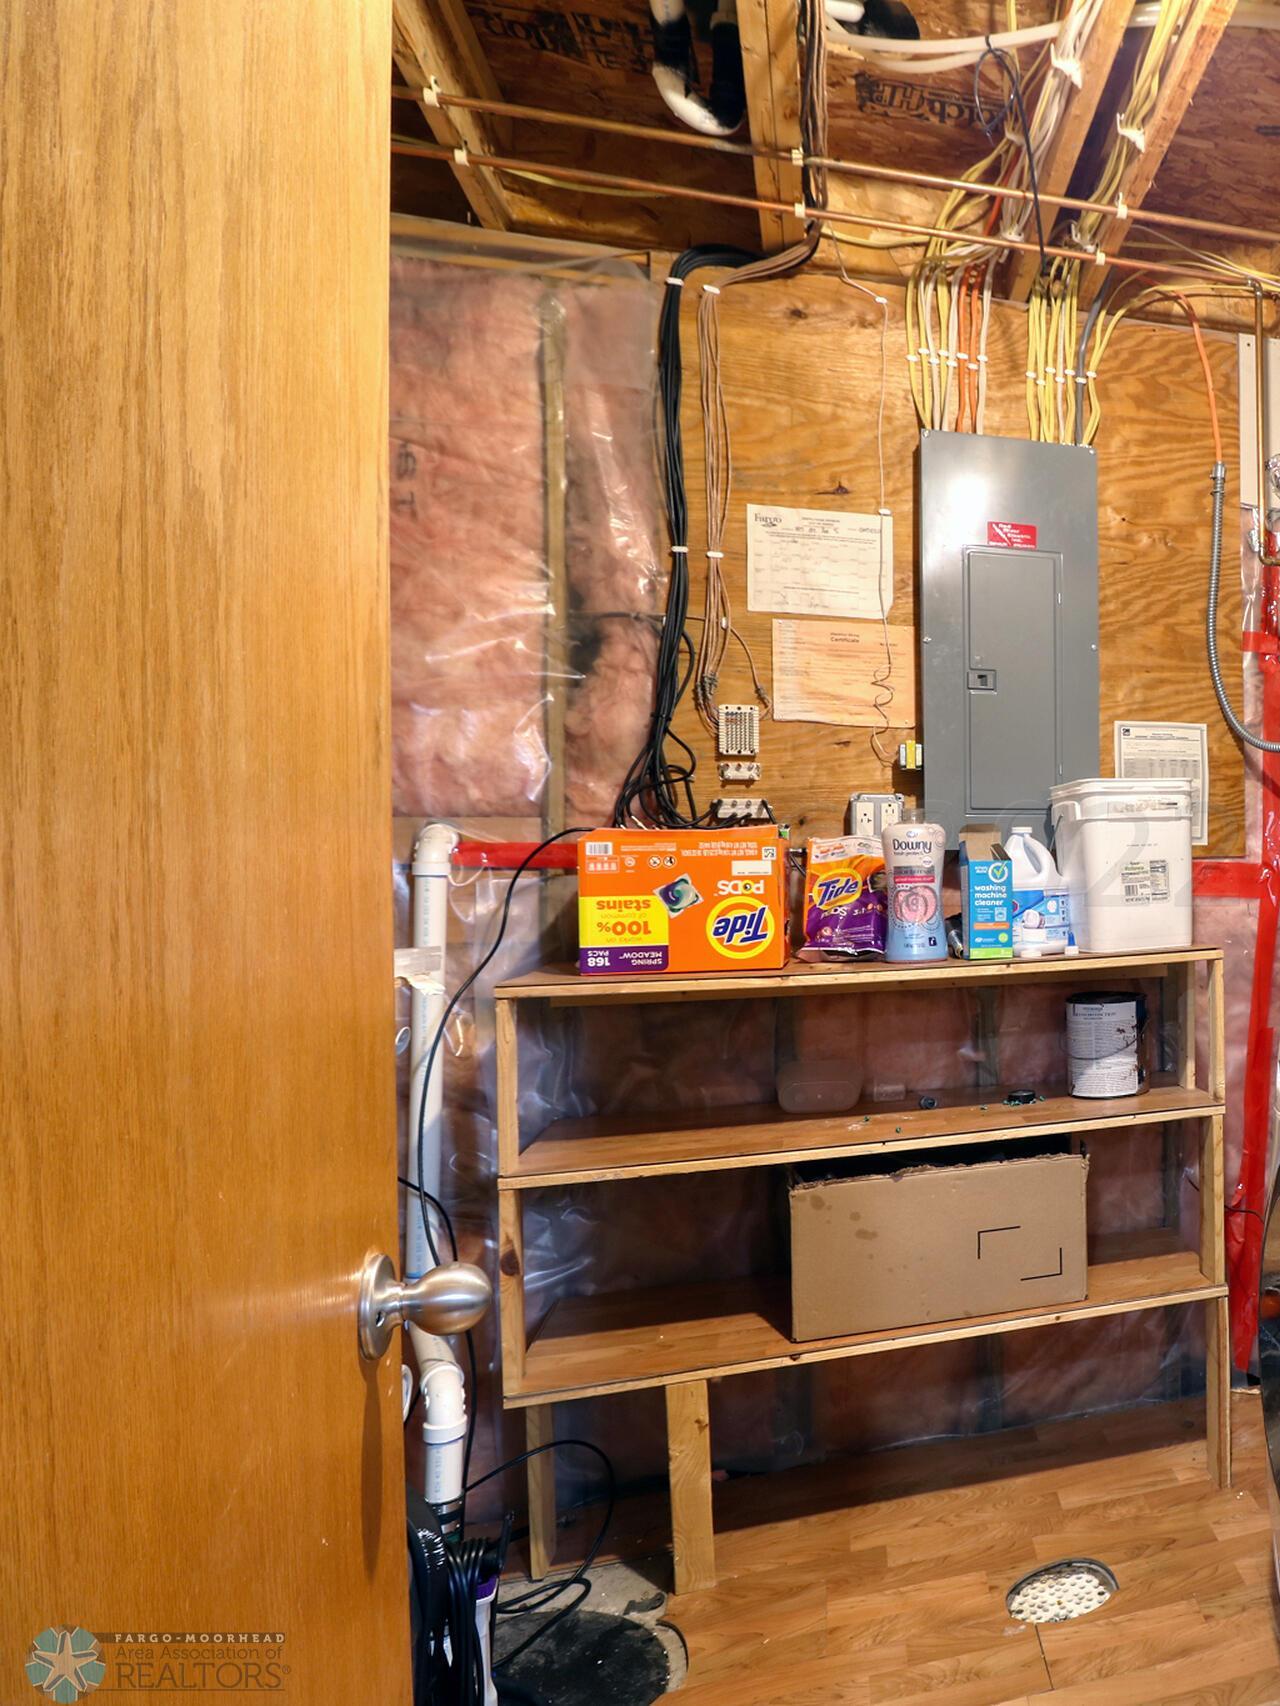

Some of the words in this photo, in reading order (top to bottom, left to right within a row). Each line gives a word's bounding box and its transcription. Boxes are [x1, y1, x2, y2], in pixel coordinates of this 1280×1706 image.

[893, 839, 933, 854] Downy
[717, 879, 765, 895] PODS
[818, 878, 859, 907] Tide
[974, 884, 1006, 893] washing
[596, 899, 651, 911] stains
[596, 921, 651, 935] 100%
[713, 906, 769, 943] Tide
[587, 957, 610, 967] 168
